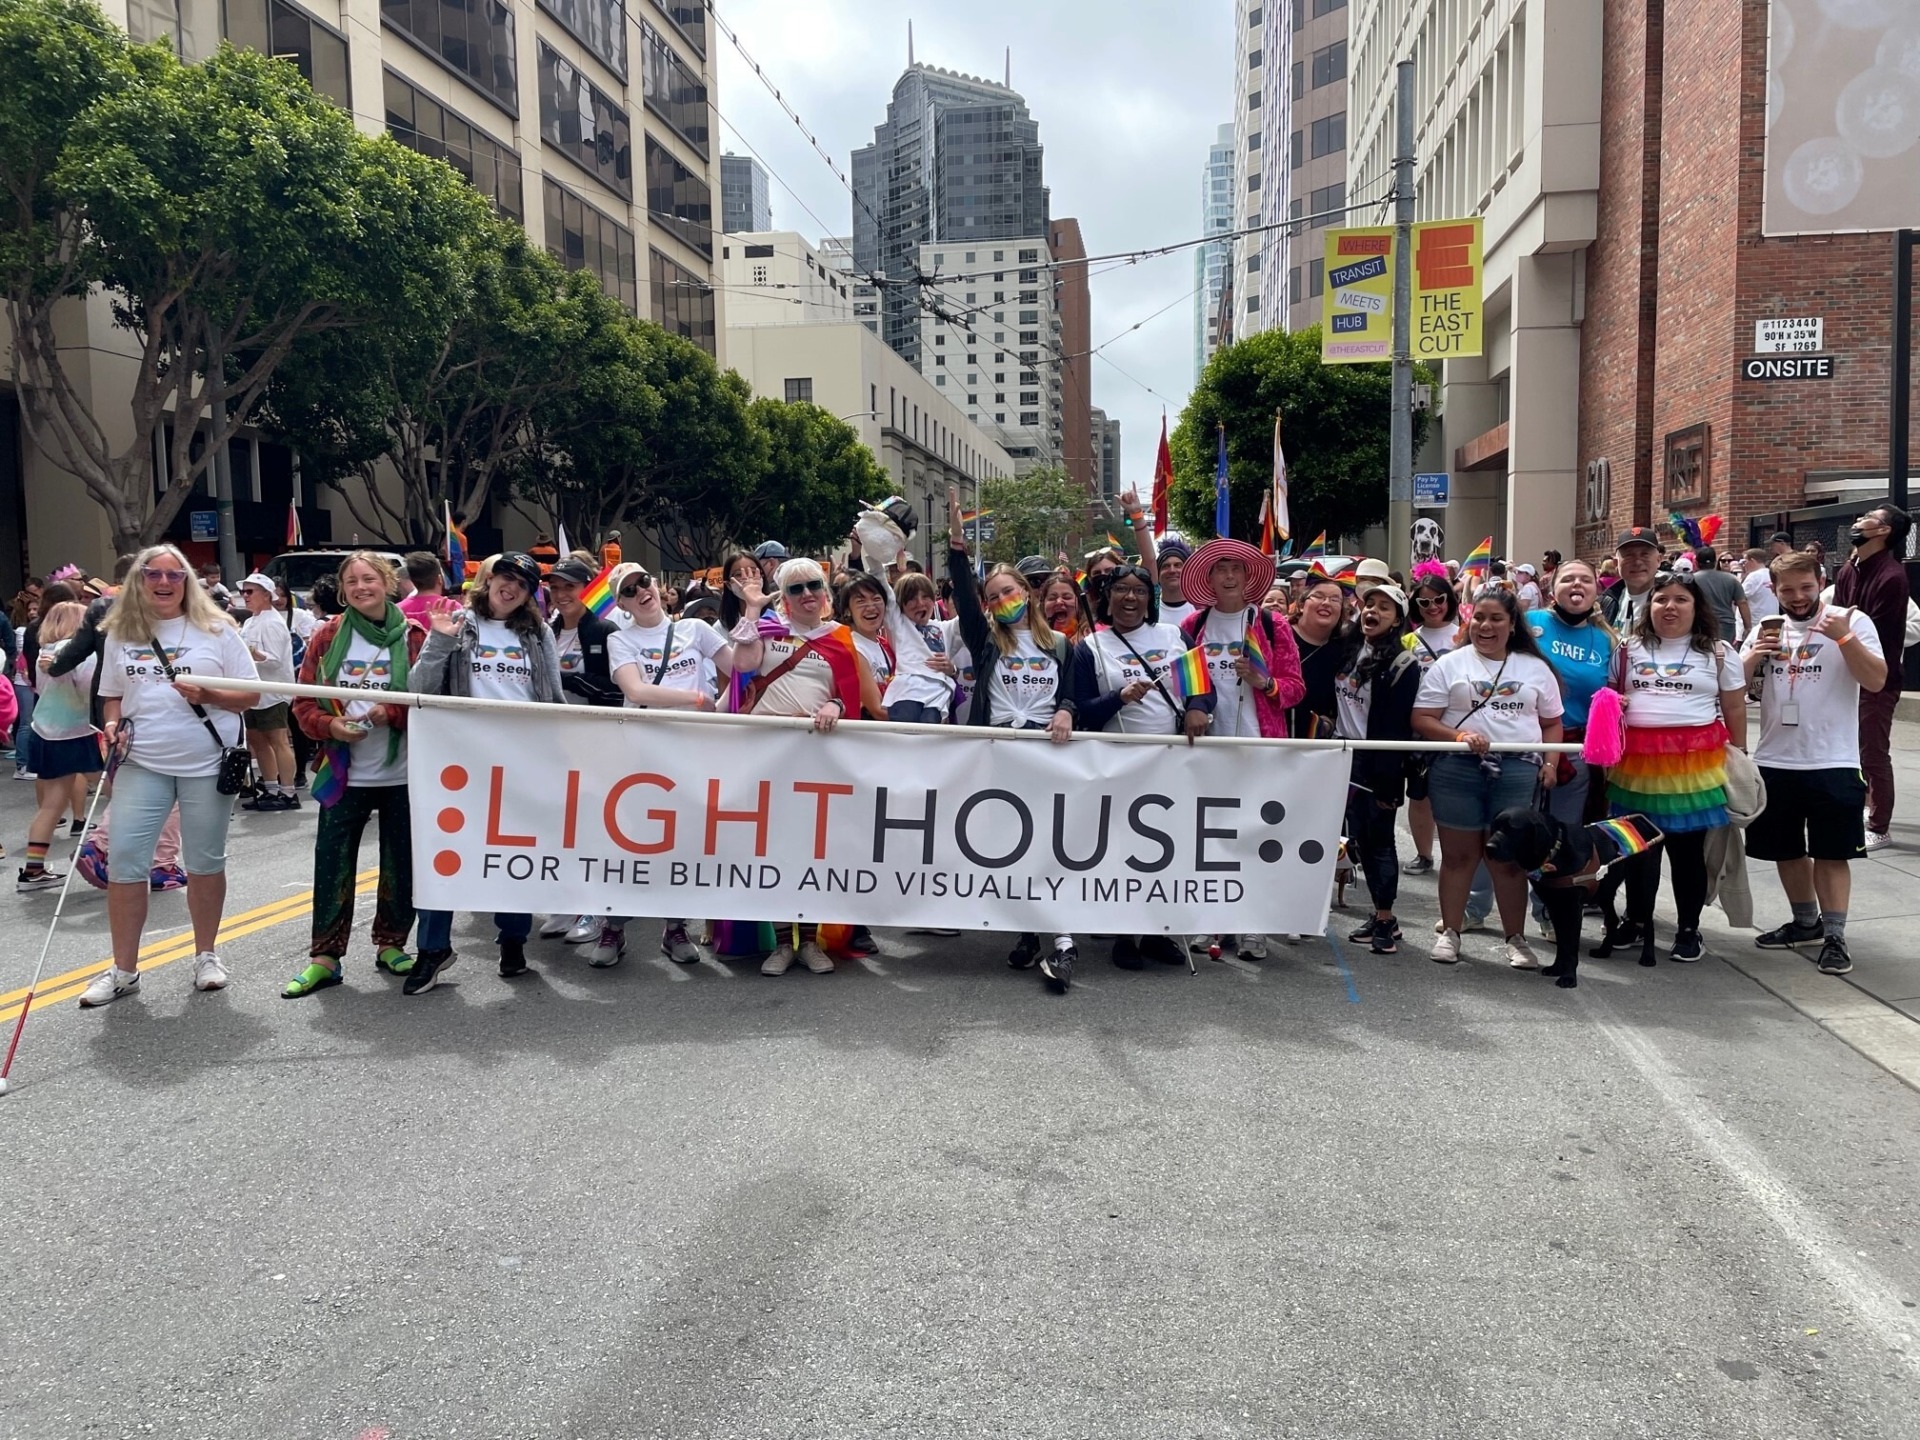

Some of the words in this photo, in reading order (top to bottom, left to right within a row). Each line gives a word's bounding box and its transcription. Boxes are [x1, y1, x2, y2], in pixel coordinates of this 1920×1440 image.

[1343, 239, 1386, 252] WHERE
[1333, 260, 1382, 284] TRANSIT
[1340, 293, 1381, 310] MEETS
[1420, 293, 1461, 313] THE
[1336, 315, 1362, 329] HUB
[1420, 312, 1474, 333] EAST
[1762, 318, 1817, 329] #1123440
[1329, 344, 1385, 355] @THEEASTCUT
[1419, 333, 1464, 353] CUT
[1775, 342, 1786, 351] SF
[1793, 341, 1817, 351] 1269
[1747, 359, 1829, 378] ONSITE
[1585, 457, 1608, 521] 60
[771, 641, 789, 653] San
[1551, 640, 1586, 661] STAFF
[126, 665, 147, 676] Be
[153, 665, 191, 676] Sen
[472, 662, 491, 673] Be
[497, 662, 531, 676] Seen
[1123, 668, 1141, 678] Be
[1787, 664, 1822, 674] Seen
[362, 680, 390, 690] See
[1002, 674, 1018, 685] Be
[1022, 674, 1054, 685] Seen
[1632, 680, 1649, 689] Be
[1655, 679, 1693, 691] Seen
[1490, 701, 1525, 711] Seen
[487, 766, 1241, 874] LIGHTHOUSE
[484, 853, 560, 882] FOR
[579, 857, 651, 885] THE
[671, 862, 781, 889] BLIND
[798, 866, 878, 894] AND
[895, 871, 1065, 901] VISUALLY
[1083, 877, 1244, 904] IMPAIRED
